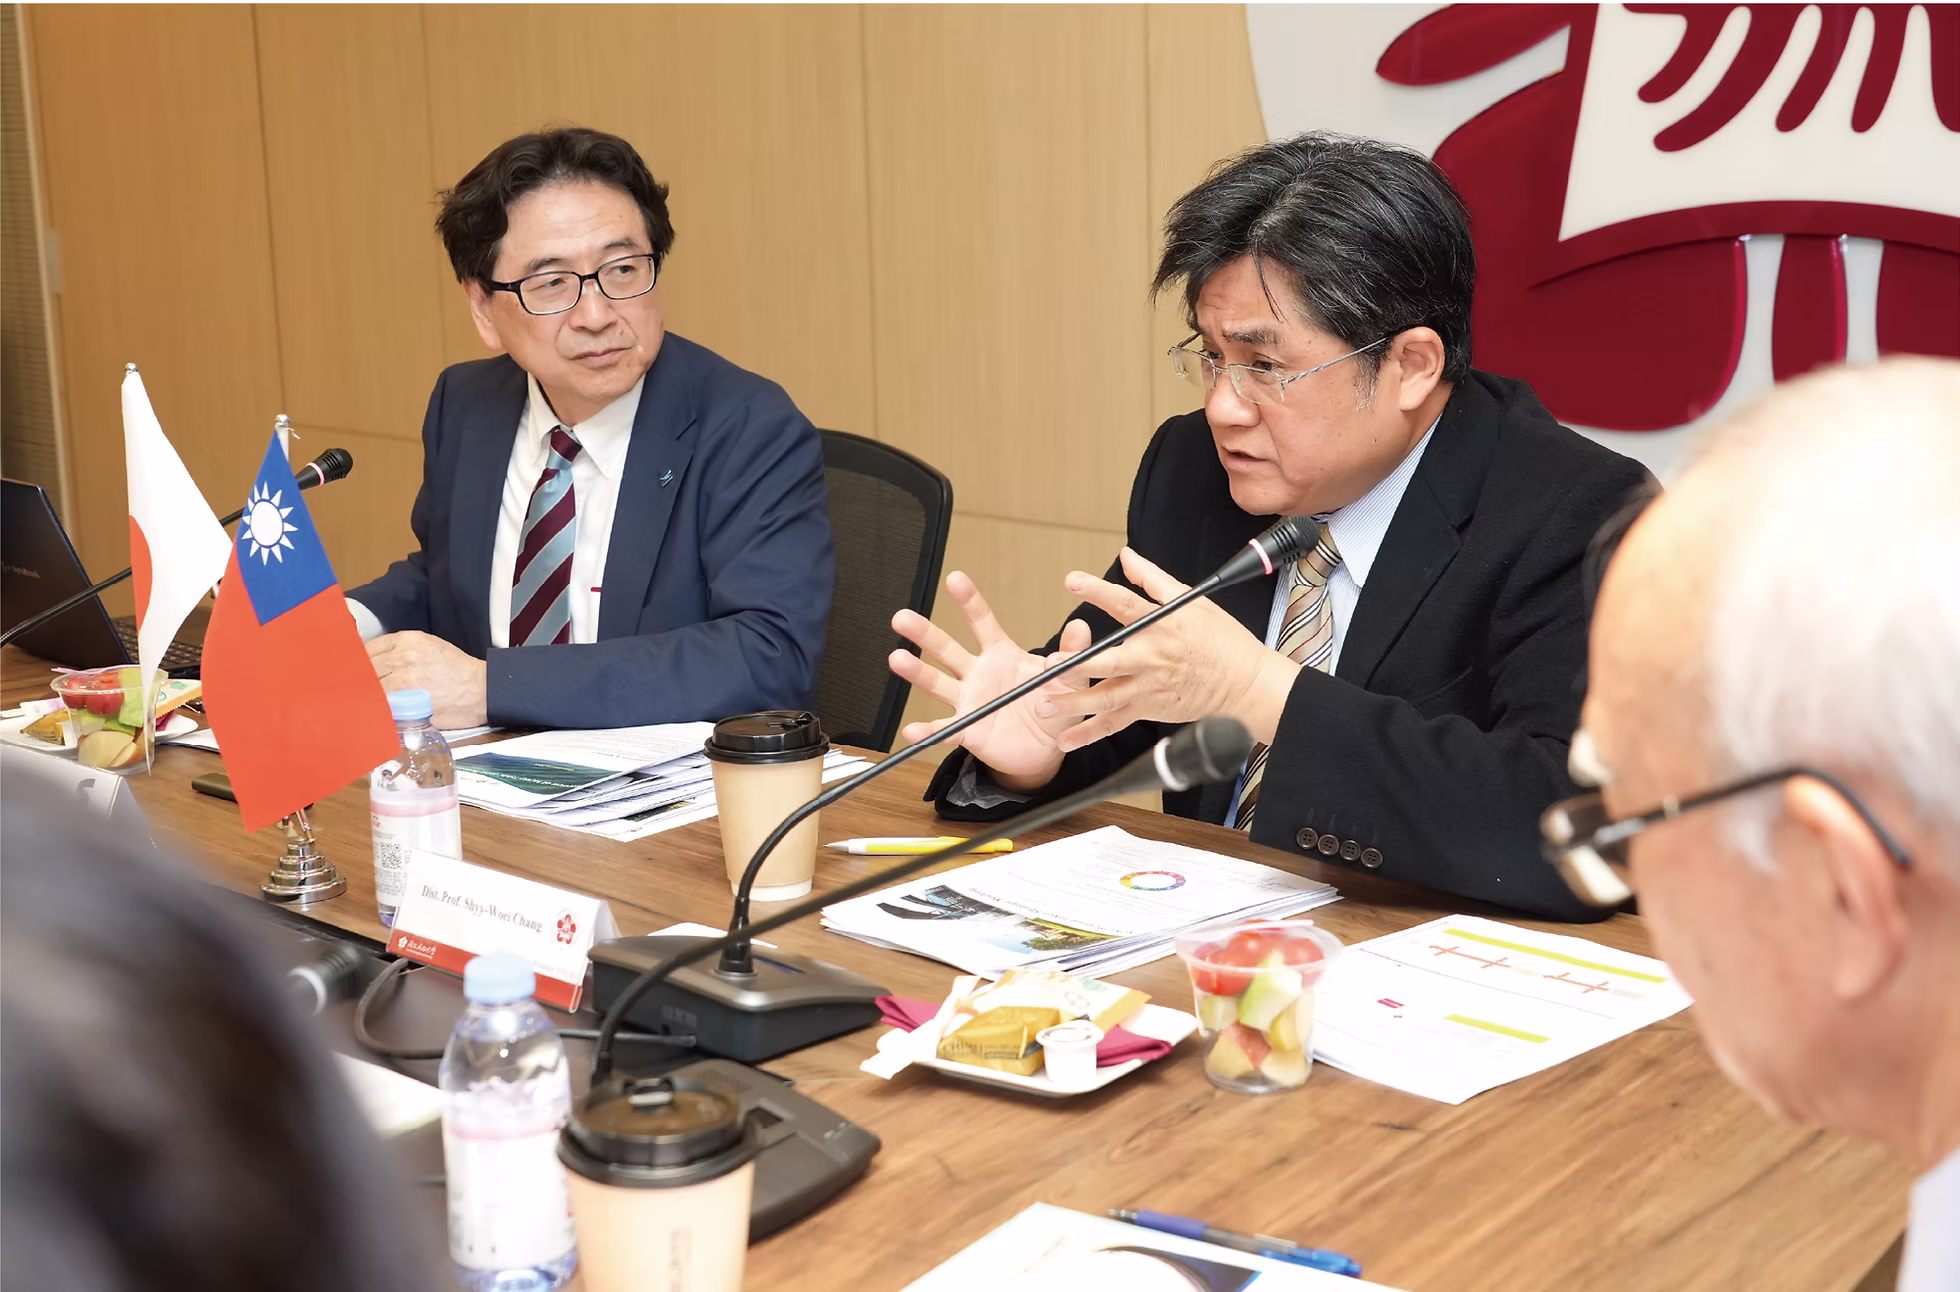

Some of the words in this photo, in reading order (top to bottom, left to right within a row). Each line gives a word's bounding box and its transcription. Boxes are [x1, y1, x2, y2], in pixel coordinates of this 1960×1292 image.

[421, 884, 440, 901] Dist.
[441, 890, 461, 907] Prof.
[513, 911, 543, 935] Chang
